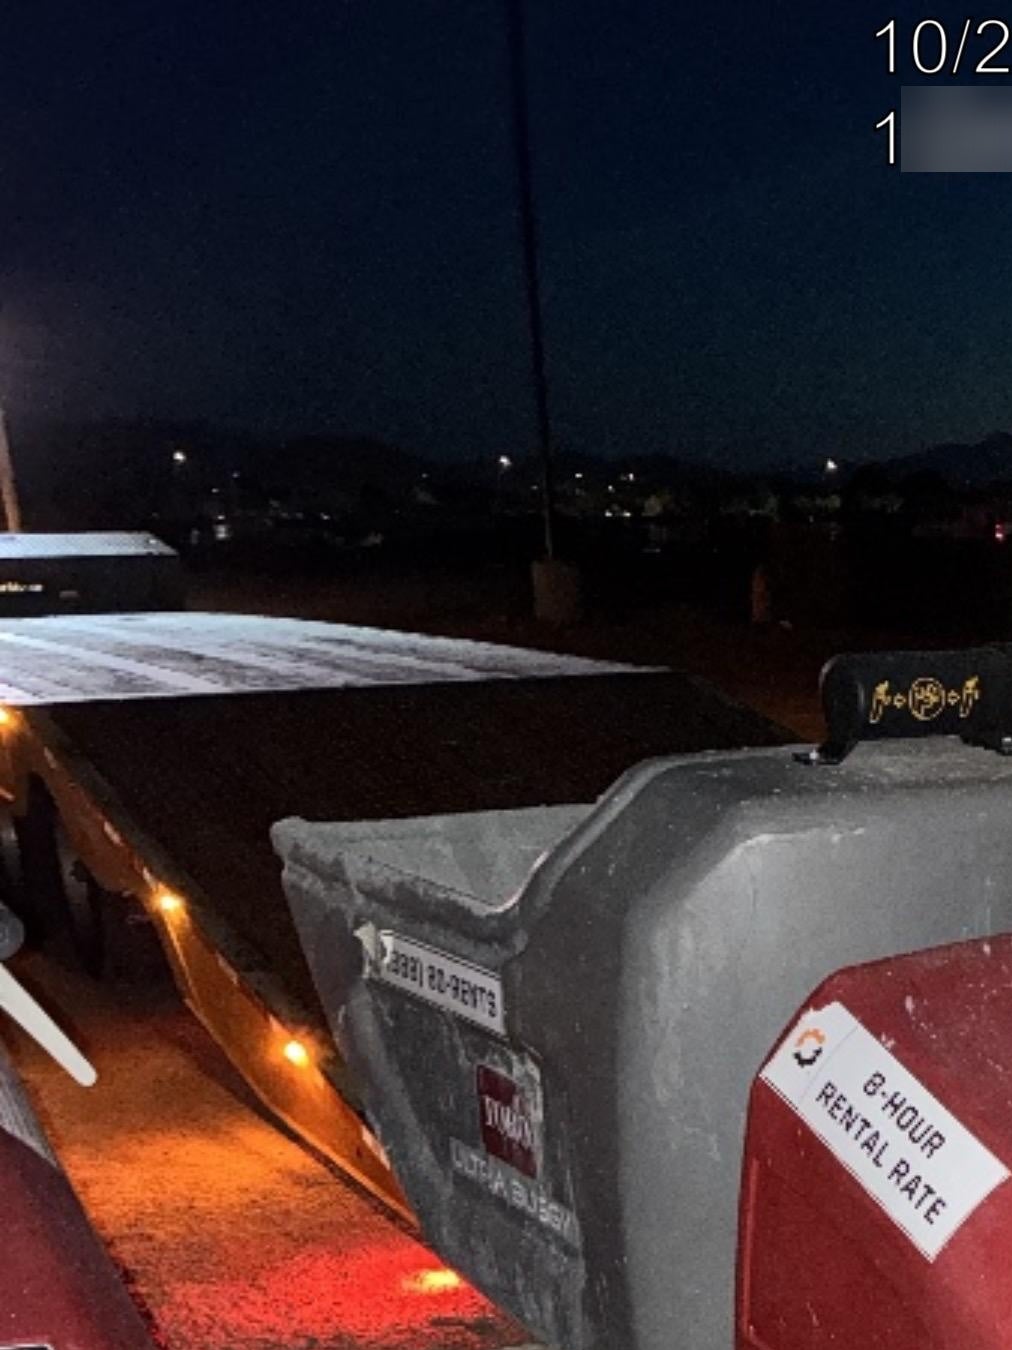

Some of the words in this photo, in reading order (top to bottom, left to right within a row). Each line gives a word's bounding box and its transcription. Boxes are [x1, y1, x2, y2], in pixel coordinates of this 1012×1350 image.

[815, 1079, 889, 1169] RENTAL
[887, 1158, 947, 1226] RATE
[862, 1070, 947, 1160] 8-HOUR
